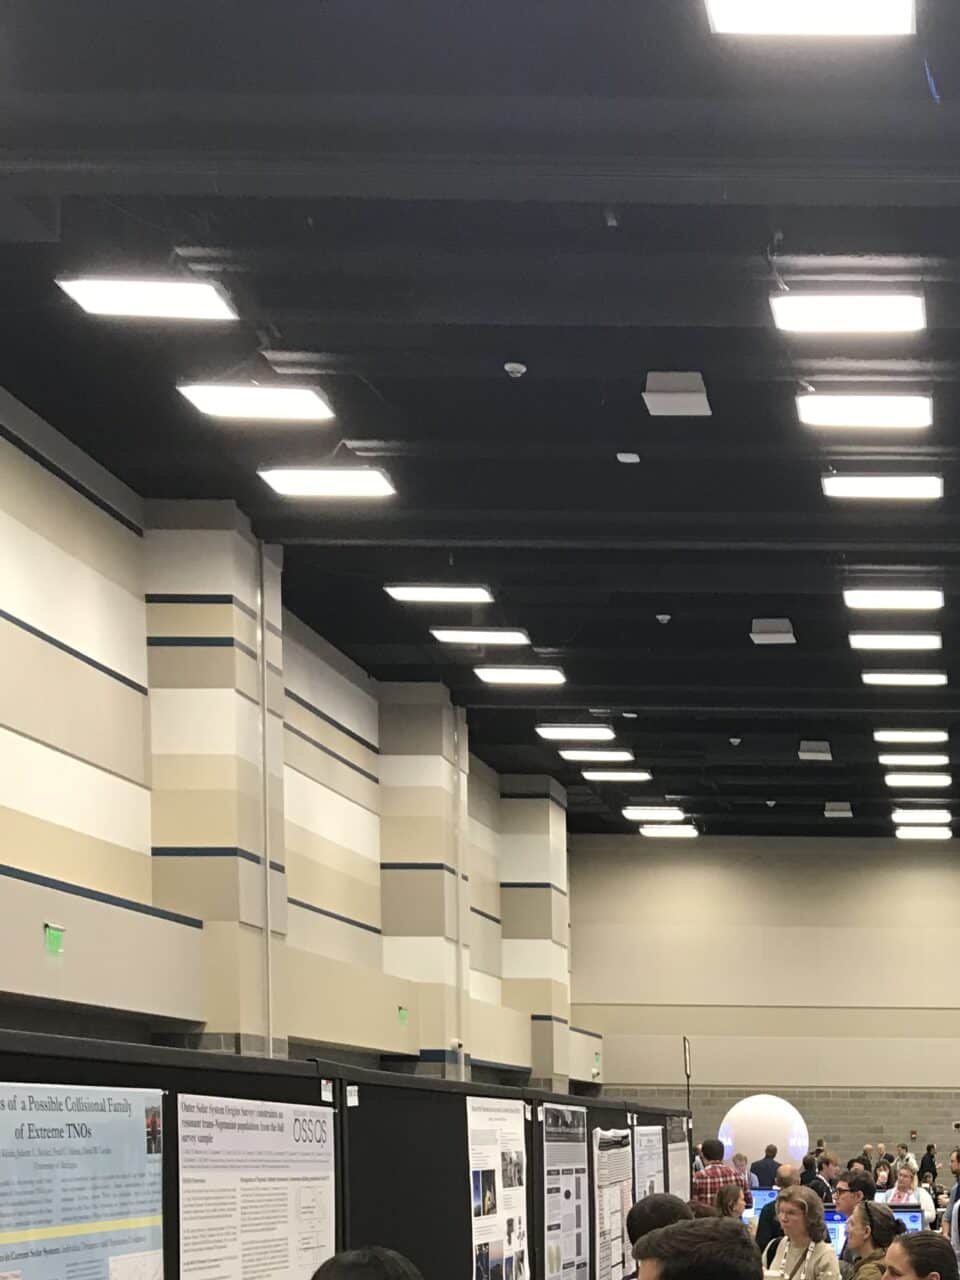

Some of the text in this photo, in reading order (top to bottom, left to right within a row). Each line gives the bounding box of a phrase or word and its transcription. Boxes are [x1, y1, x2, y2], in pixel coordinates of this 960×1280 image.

[7, 1094, 18, 1111] of
[21, 1100, 26, 1111] a
[28, 1095, 63, 1112] Possible
[65, 1095, 106, 1113] Collisional
[108, 1097, 132, 1117] Family
[14, 1122, 93, 1140] of Extreme TNOs
